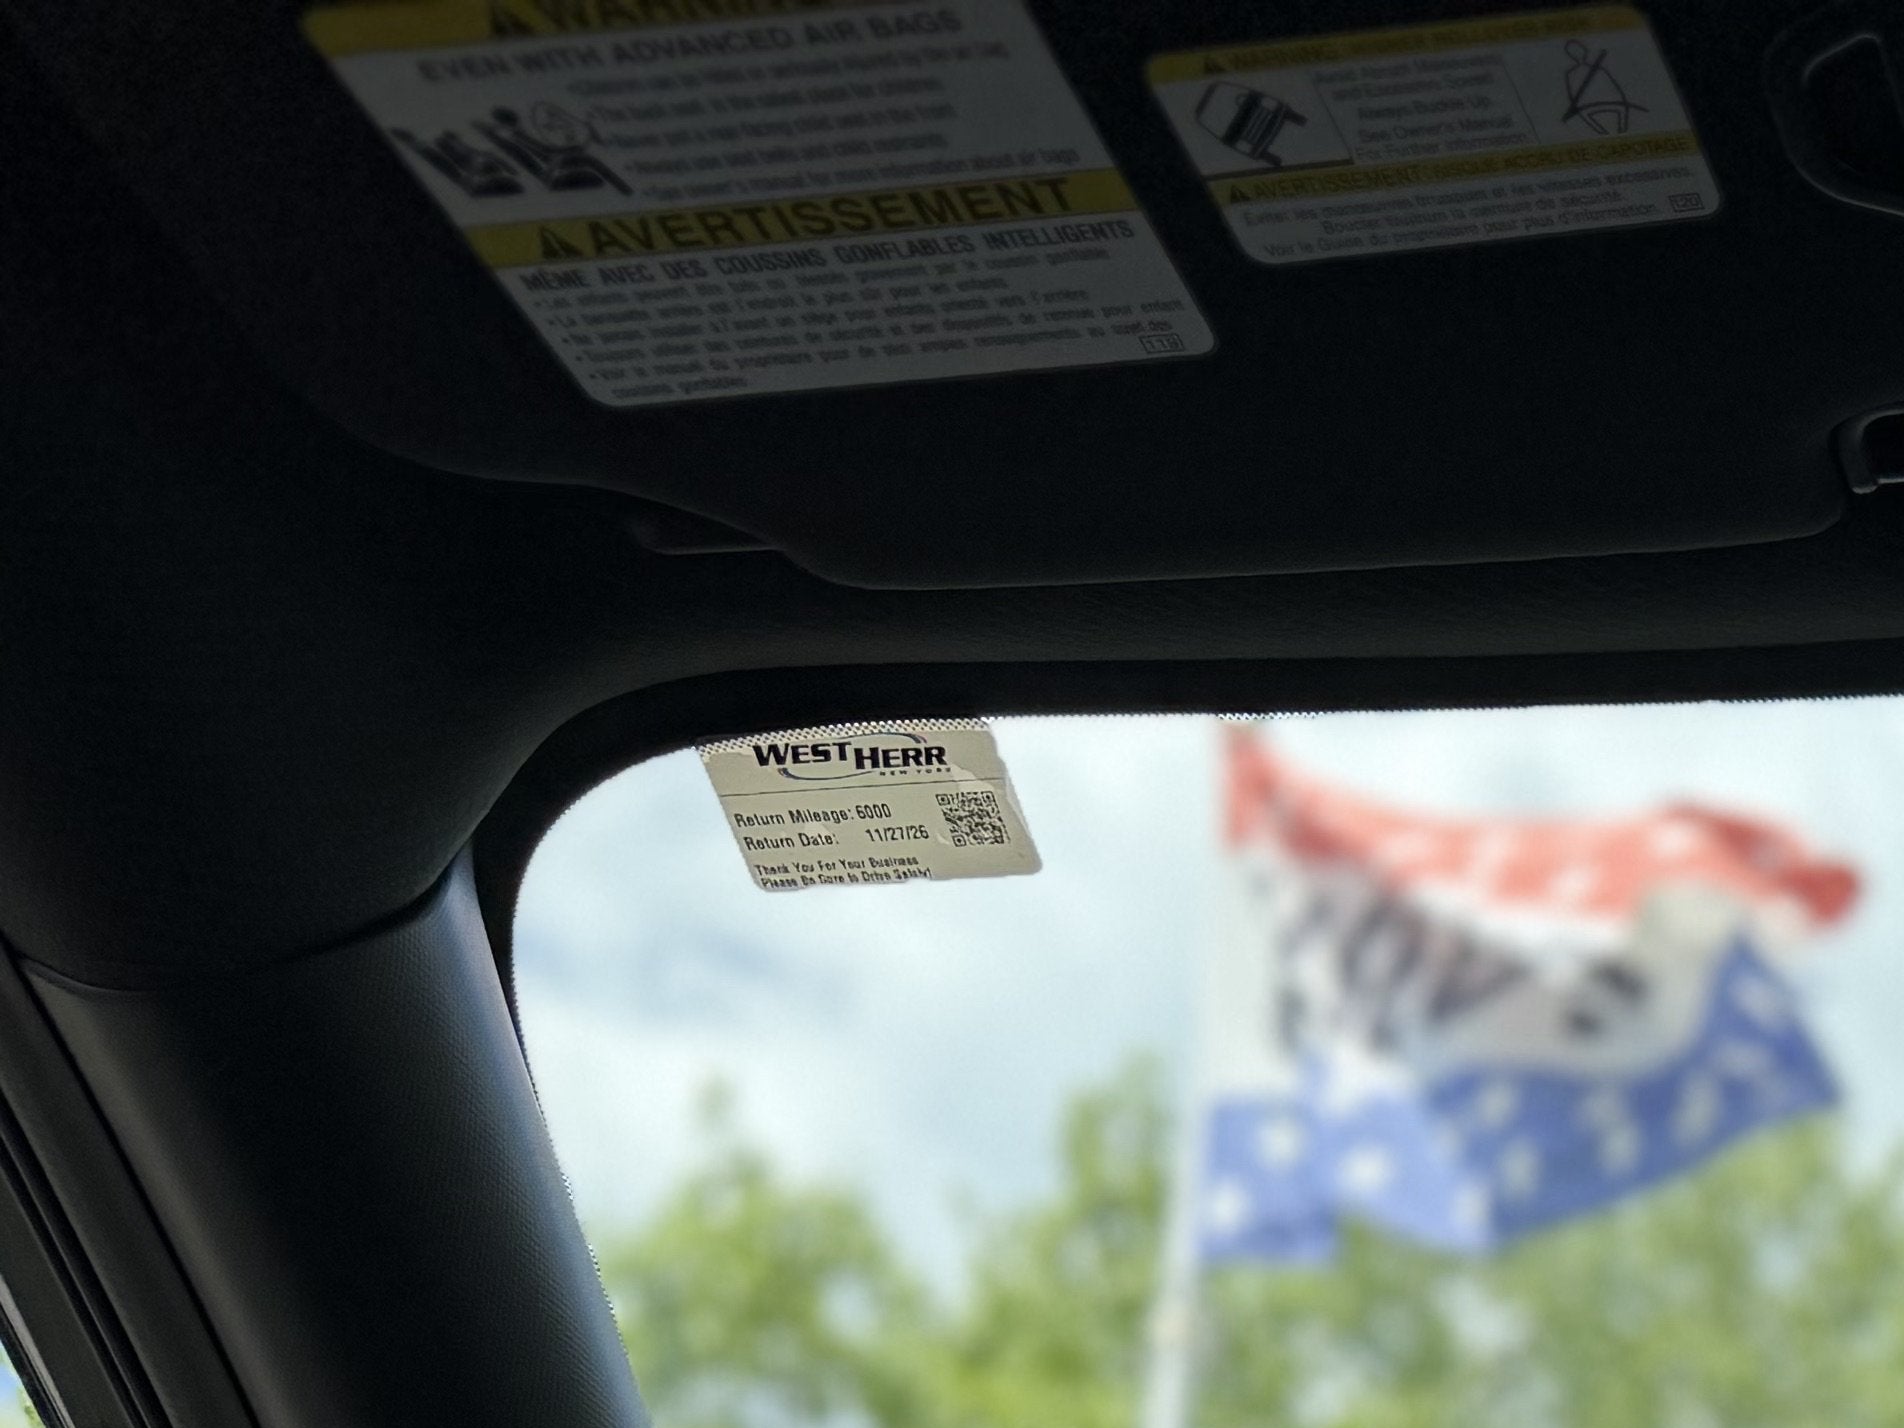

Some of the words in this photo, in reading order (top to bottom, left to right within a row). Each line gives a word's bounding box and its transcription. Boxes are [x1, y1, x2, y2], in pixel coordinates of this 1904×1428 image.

[515, 46, 604, 74] WITH
[610, 28, 795, 65] ADVANCED
[803, 20, 863, 46] AIR
[867, 9, 963, 39] BAGS
[588, 177, 1071, 257] AVERTISSEMENT
[598, 261, 656, 286] AVEC
[662, 258, 709, 280] DES
[713, 247, 828, 276] COUSSINS
[834, 233, 977, 264] GONFLABLES
[982, 218, 1135, 250] INTELLIGENTS
[752, 740, 853, 767] WEST
[854, 745, 948, 770] HERR
[734, 812, 785, 828] Return
[788, 807, 855, 825] Mileage:
[855, 803, 892, 820] 6000
[743, 835, 795, 852] Return
[798, 831, 840, 848] Date:
[864, 824, 930, 843] 11/27/26
[754, 863, 790, 876] Thank
[792, 861, 815, 874] You
[817, 860, 837, 872] For
[838, 858, 866, 870] Your
[868, 856, 920, 869] Business
